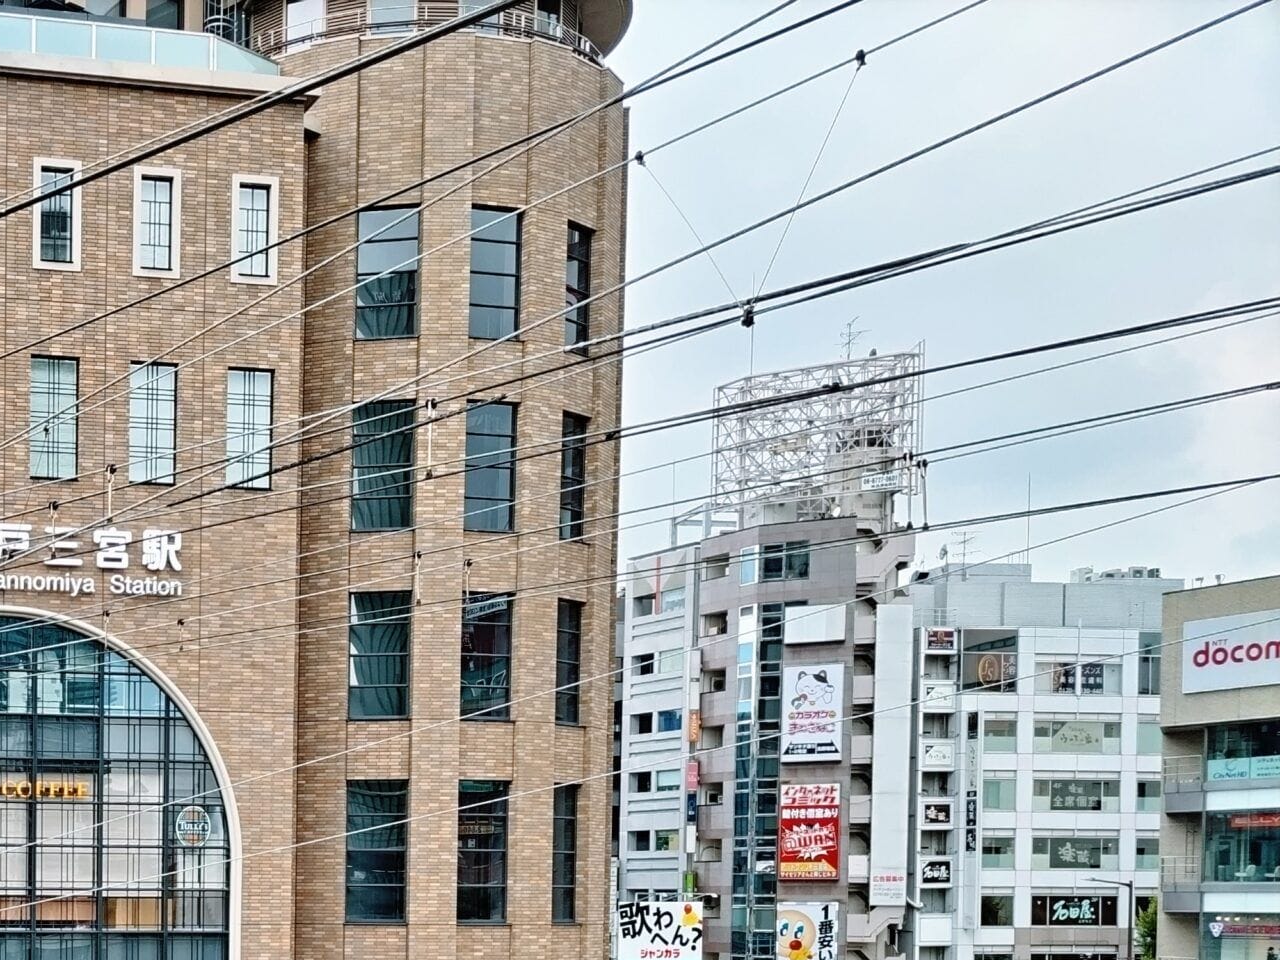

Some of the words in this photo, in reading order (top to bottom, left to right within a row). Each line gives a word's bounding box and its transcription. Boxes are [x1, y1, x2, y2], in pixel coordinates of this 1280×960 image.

[109, 575, 182, 596] Station
[2, 779, 89, 799] COFFEE
[783, 796, 836, 804] コミック
[640, 949, 680, 958] ジャンカラ
